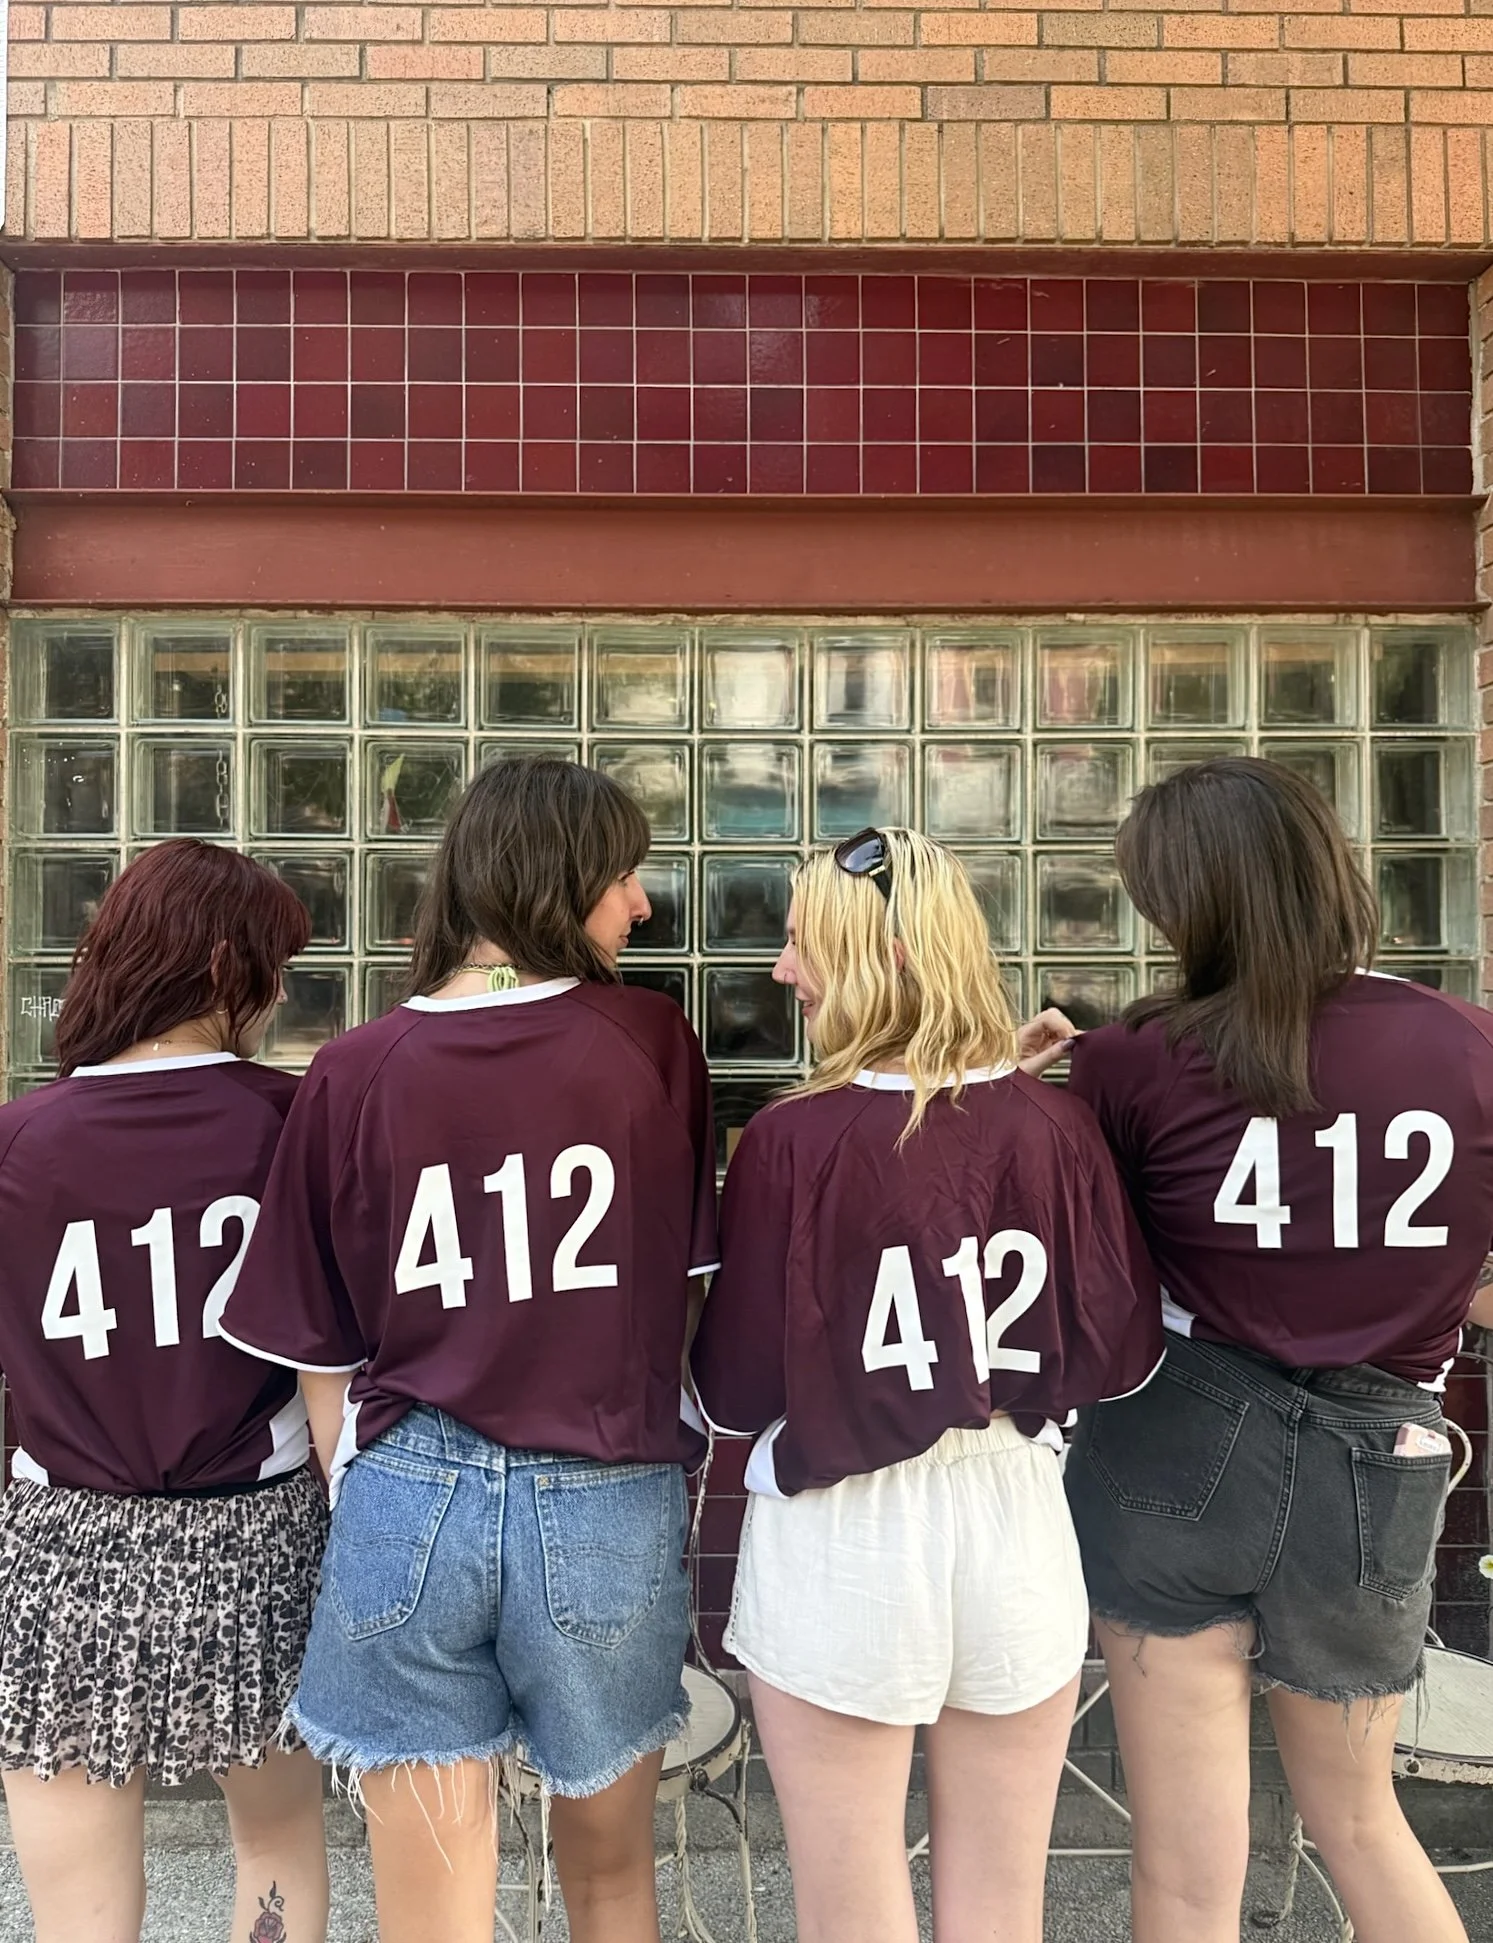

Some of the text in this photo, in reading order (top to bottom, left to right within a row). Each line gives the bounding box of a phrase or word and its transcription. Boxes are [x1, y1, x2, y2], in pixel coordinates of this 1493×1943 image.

[394, 1144, 618, 1309] 412
[1213, 1110, 1455, 1248] 412
[42, 1196, 261, 1360] 412
[861, 1230, 1048, 1390] 412
